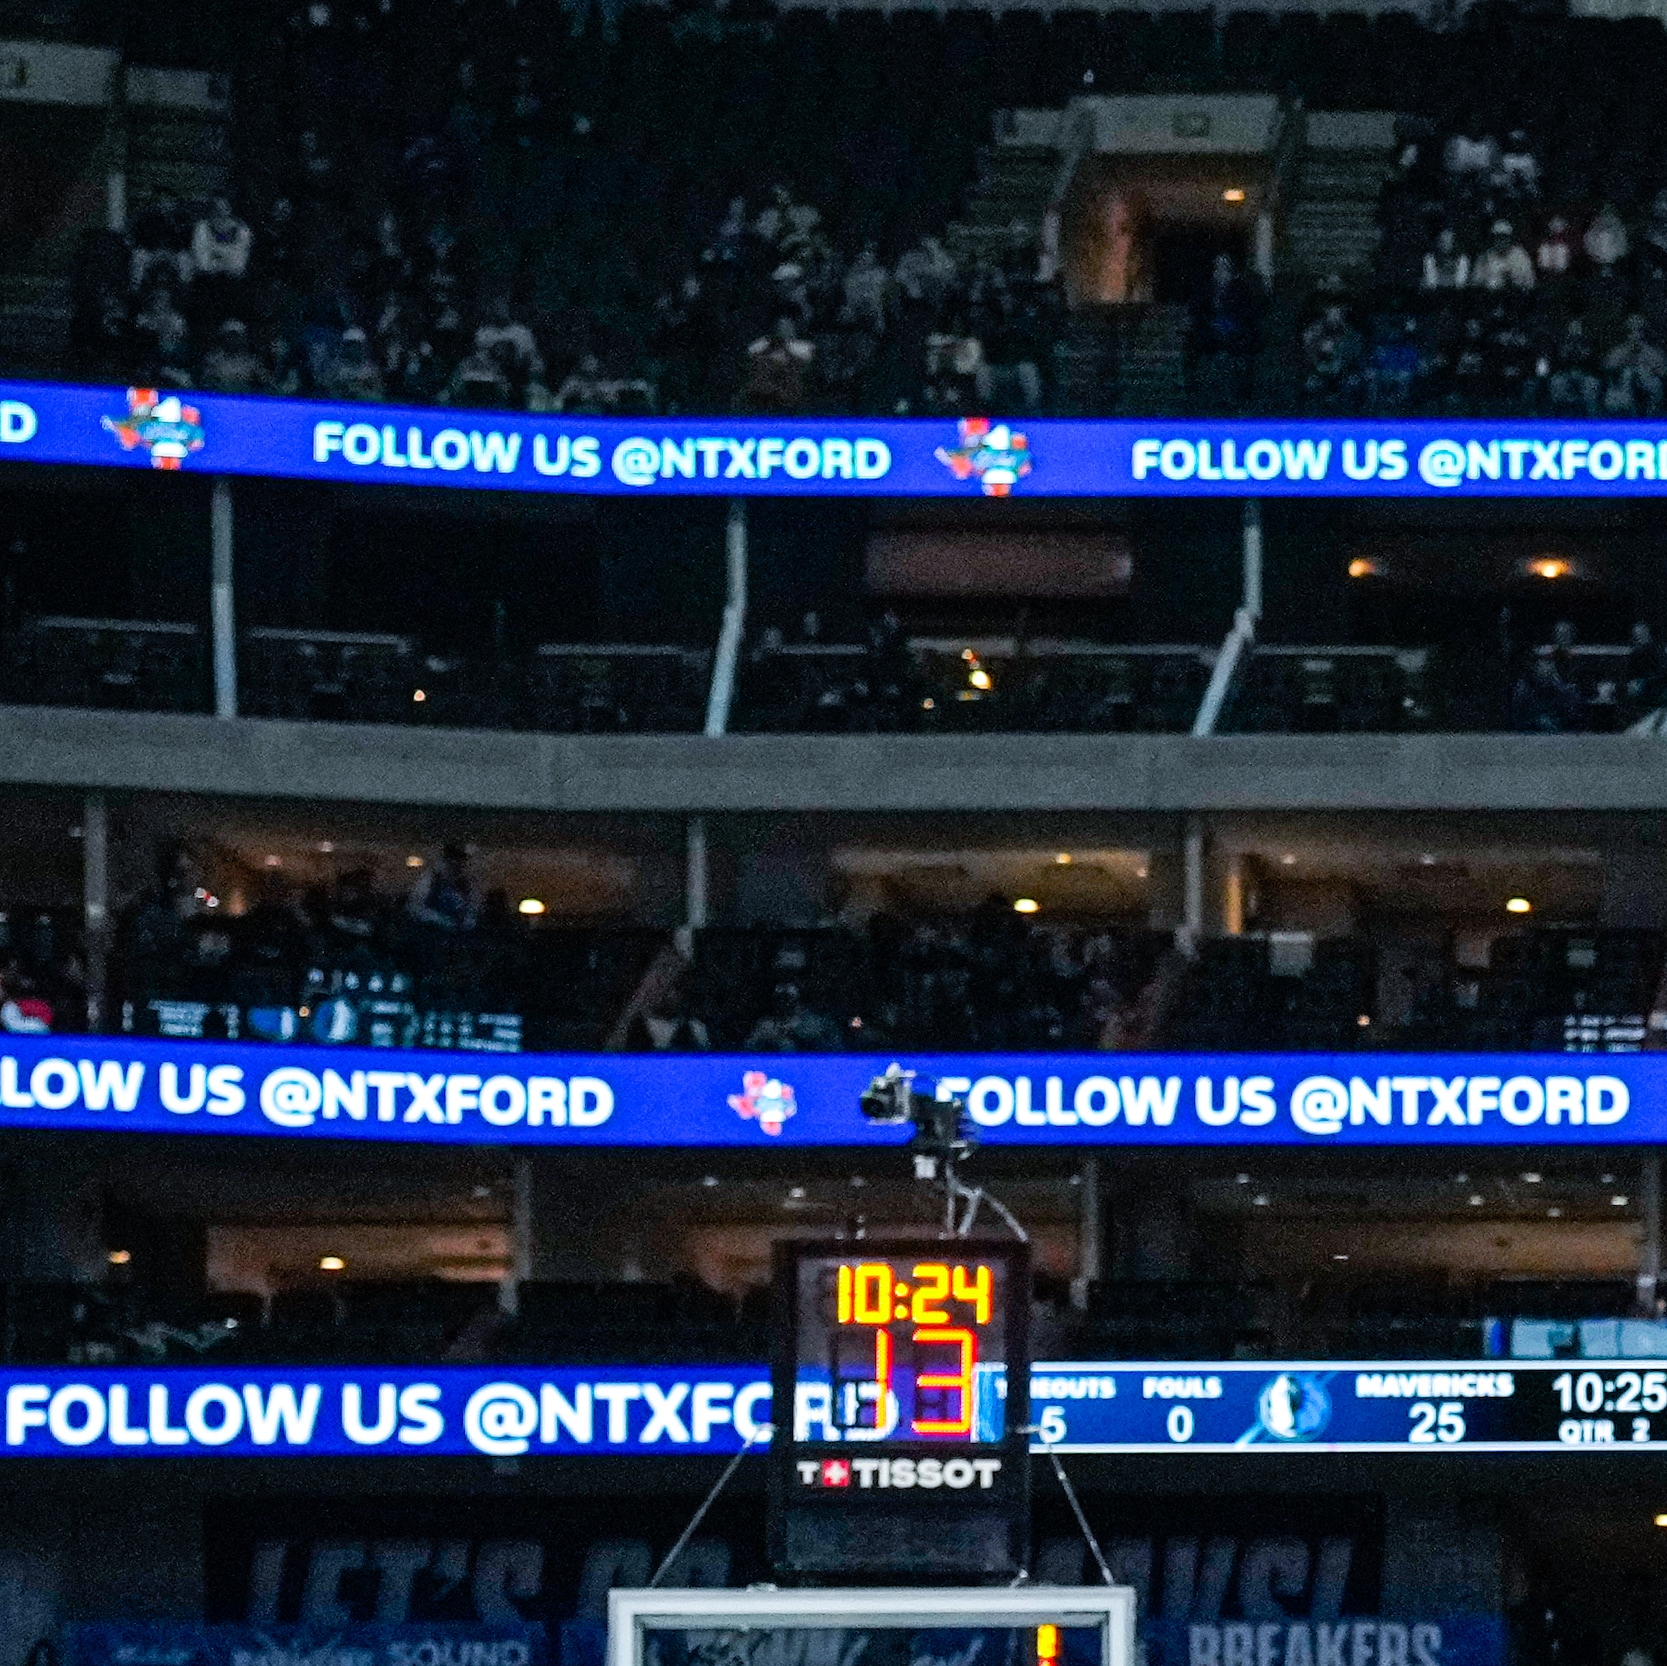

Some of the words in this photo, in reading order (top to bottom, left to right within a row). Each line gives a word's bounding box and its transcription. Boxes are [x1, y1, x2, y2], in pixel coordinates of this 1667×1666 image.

[314, 424, 520, 472] FOLLOW
[534, 437, 599, 477] US
[612, 438, 890, 485] @NTXFORD
[1132, 440, 1329, 479] FOLLOW
[1343, 441, 1406, 479] US
[0, 1057, 144, 1111] LOW
[160, 1063, 244, 1115] US
[260, 1068, 613, 1126] @NTXFORD
[1196, 1077, 1275, 1125] US
[1291, 1076, 1629, 1134] @NTXFORD
[836, 1263, 993, 1325] 10:24
[875, 1327, 977, 1434] 13
[1143, 1377, 1222, 1399] FOULS
[1356, 1374, 1515, 1398] MAVERICKS
[7, 1385, 320, 1445] FOLLOW
[342, 1384, 443, 1444] US
[1040, 1406, 1066, 1444] 5
[1167, 1406, 1193, 1442] 0
[1408, 1402, 1466, 1443] 25
[1632, 1420, 1650, 1443] 2
[853, 1459, 1002, 1488] TISSOT
